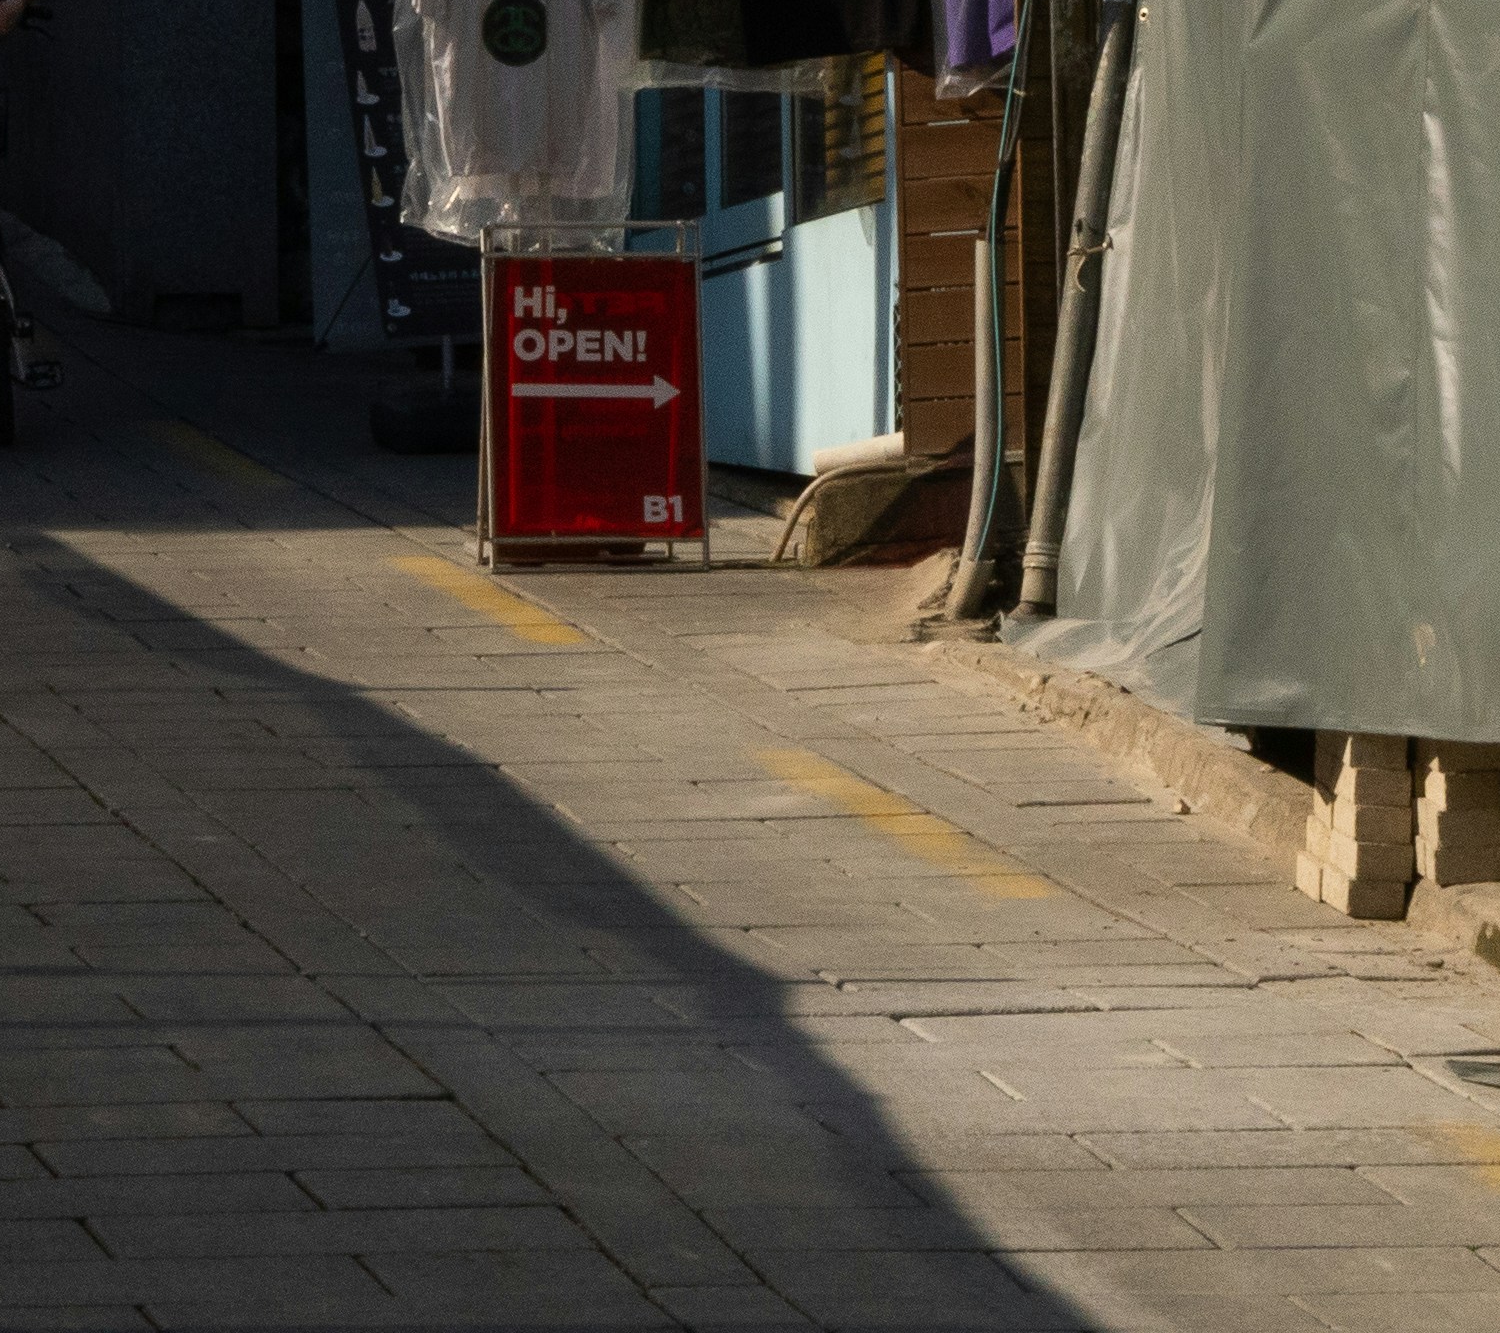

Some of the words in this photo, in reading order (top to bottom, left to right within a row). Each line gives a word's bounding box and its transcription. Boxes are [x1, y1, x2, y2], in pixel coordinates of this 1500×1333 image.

[513, 285, 569, 325] Hi,
[512, 327, 648, 364] OPEN!
[642, 494, 684, 524] B1
